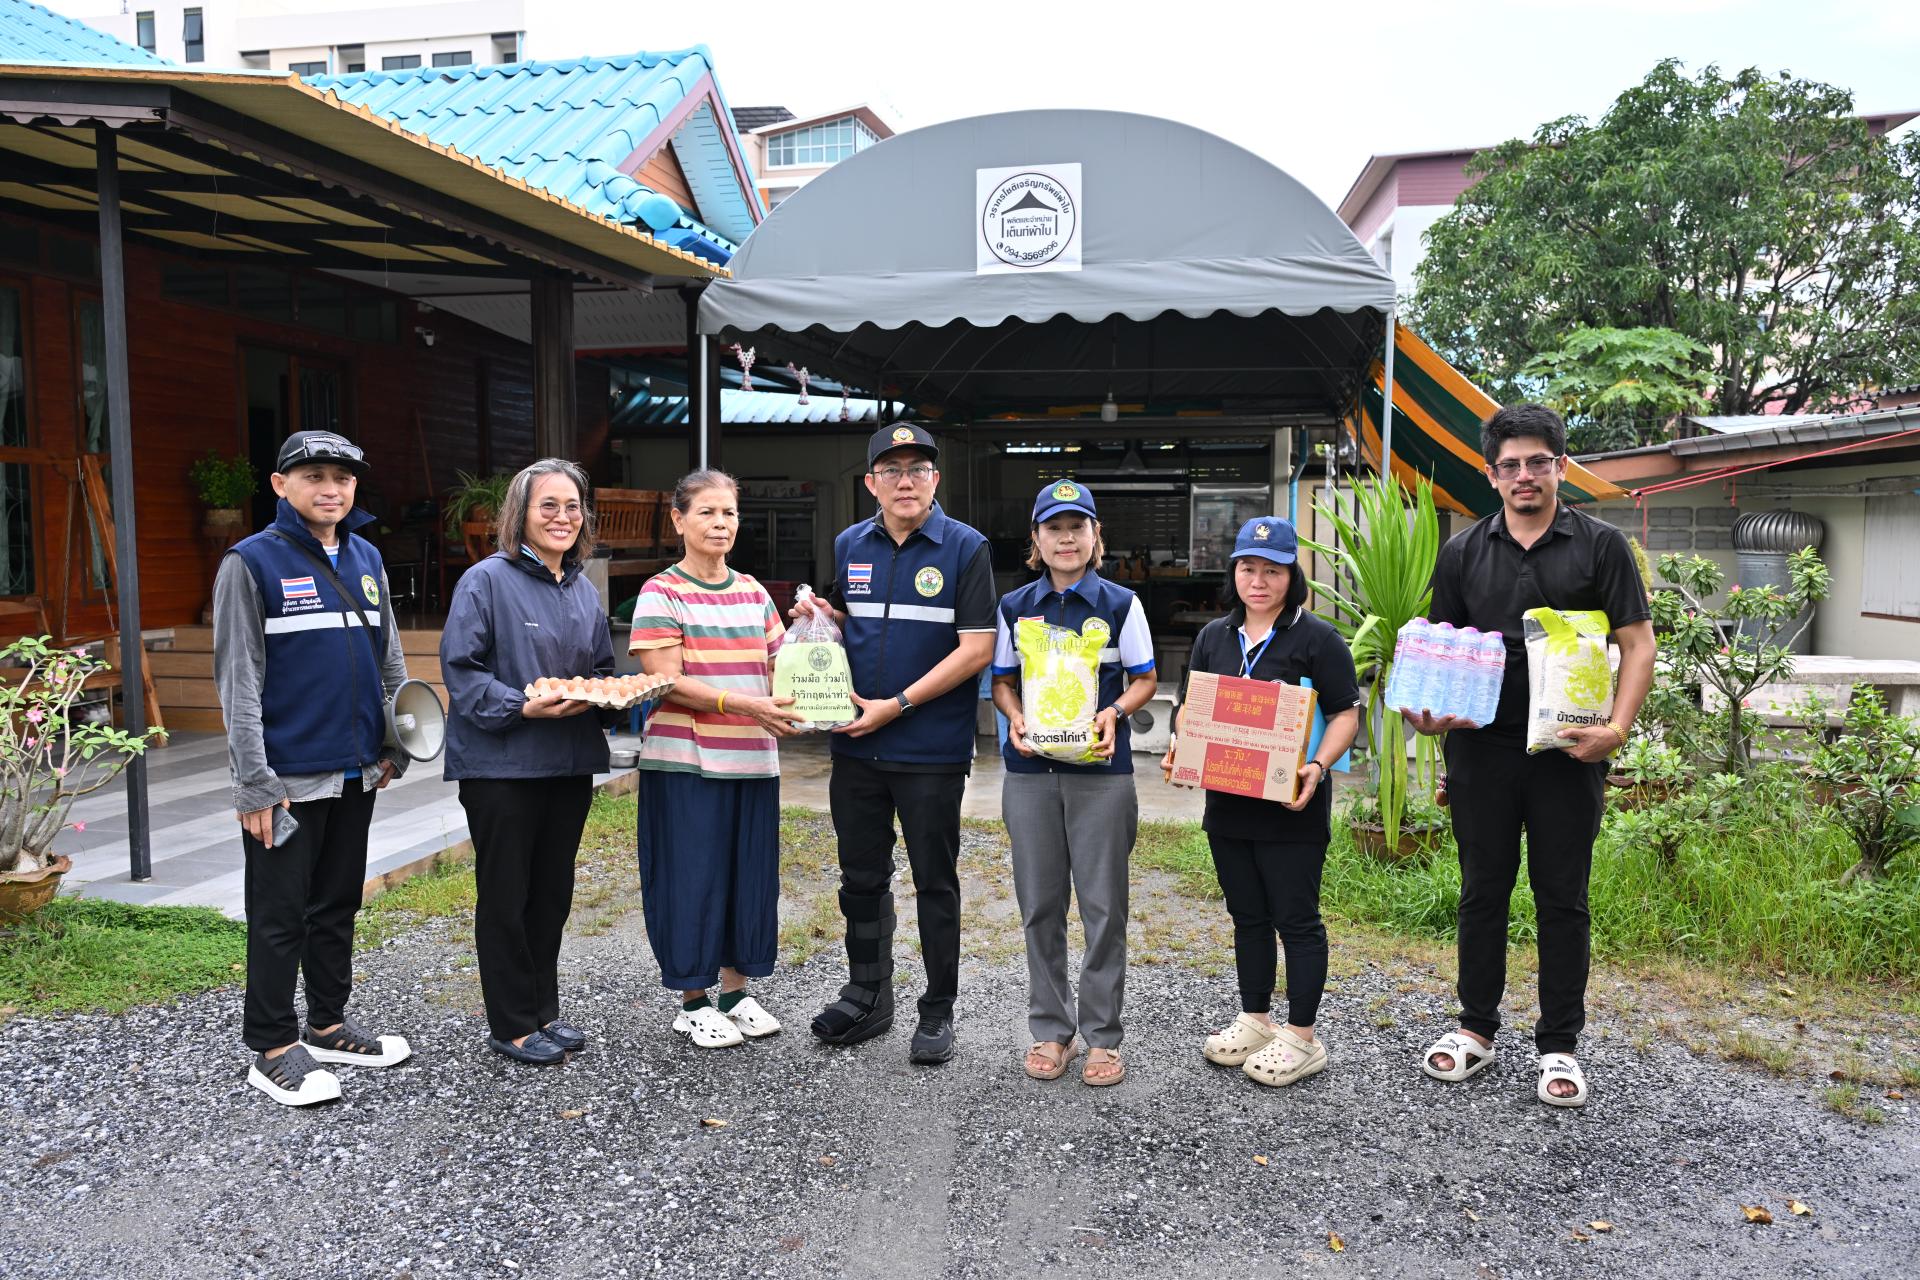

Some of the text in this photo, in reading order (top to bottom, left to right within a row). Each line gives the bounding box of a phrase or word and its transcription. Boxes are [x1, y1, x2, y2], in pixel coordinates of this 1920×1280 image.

[1006, 223, 1052, 238] เต็นท์ผ้าใบ
[1004, 240, 1058, 260] 094-3569996
[791, 672, 820, 683] ร่วมมือ
